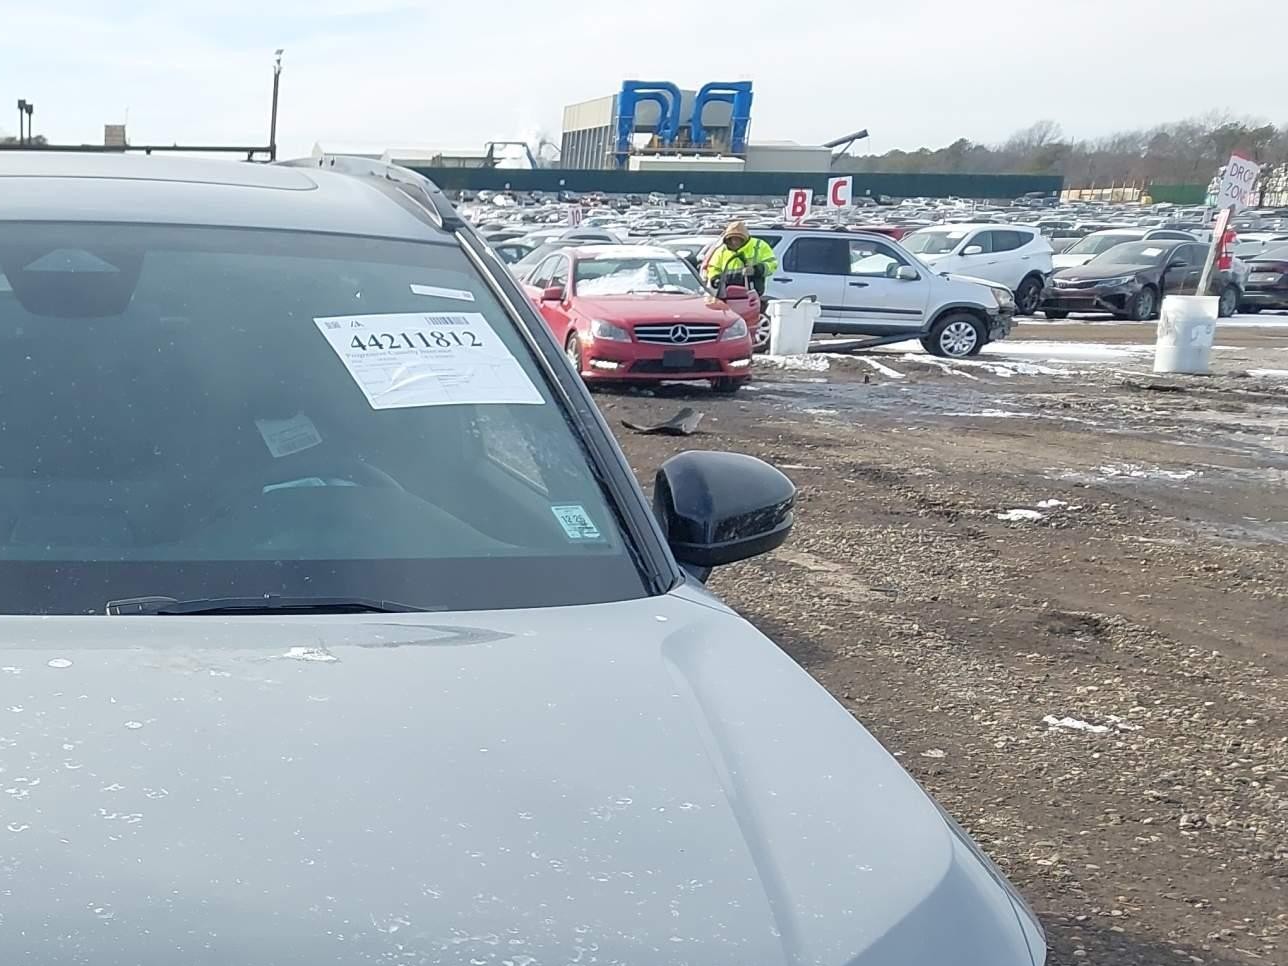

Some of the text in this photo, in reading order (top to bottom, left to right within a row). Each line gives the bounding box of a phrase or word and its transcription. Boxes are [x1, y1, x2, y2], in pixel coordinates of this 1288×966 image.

[791, 191, 807, 217] B
[831, 180, 847, 206] C
[350, 330, 483, 352] 44211812
